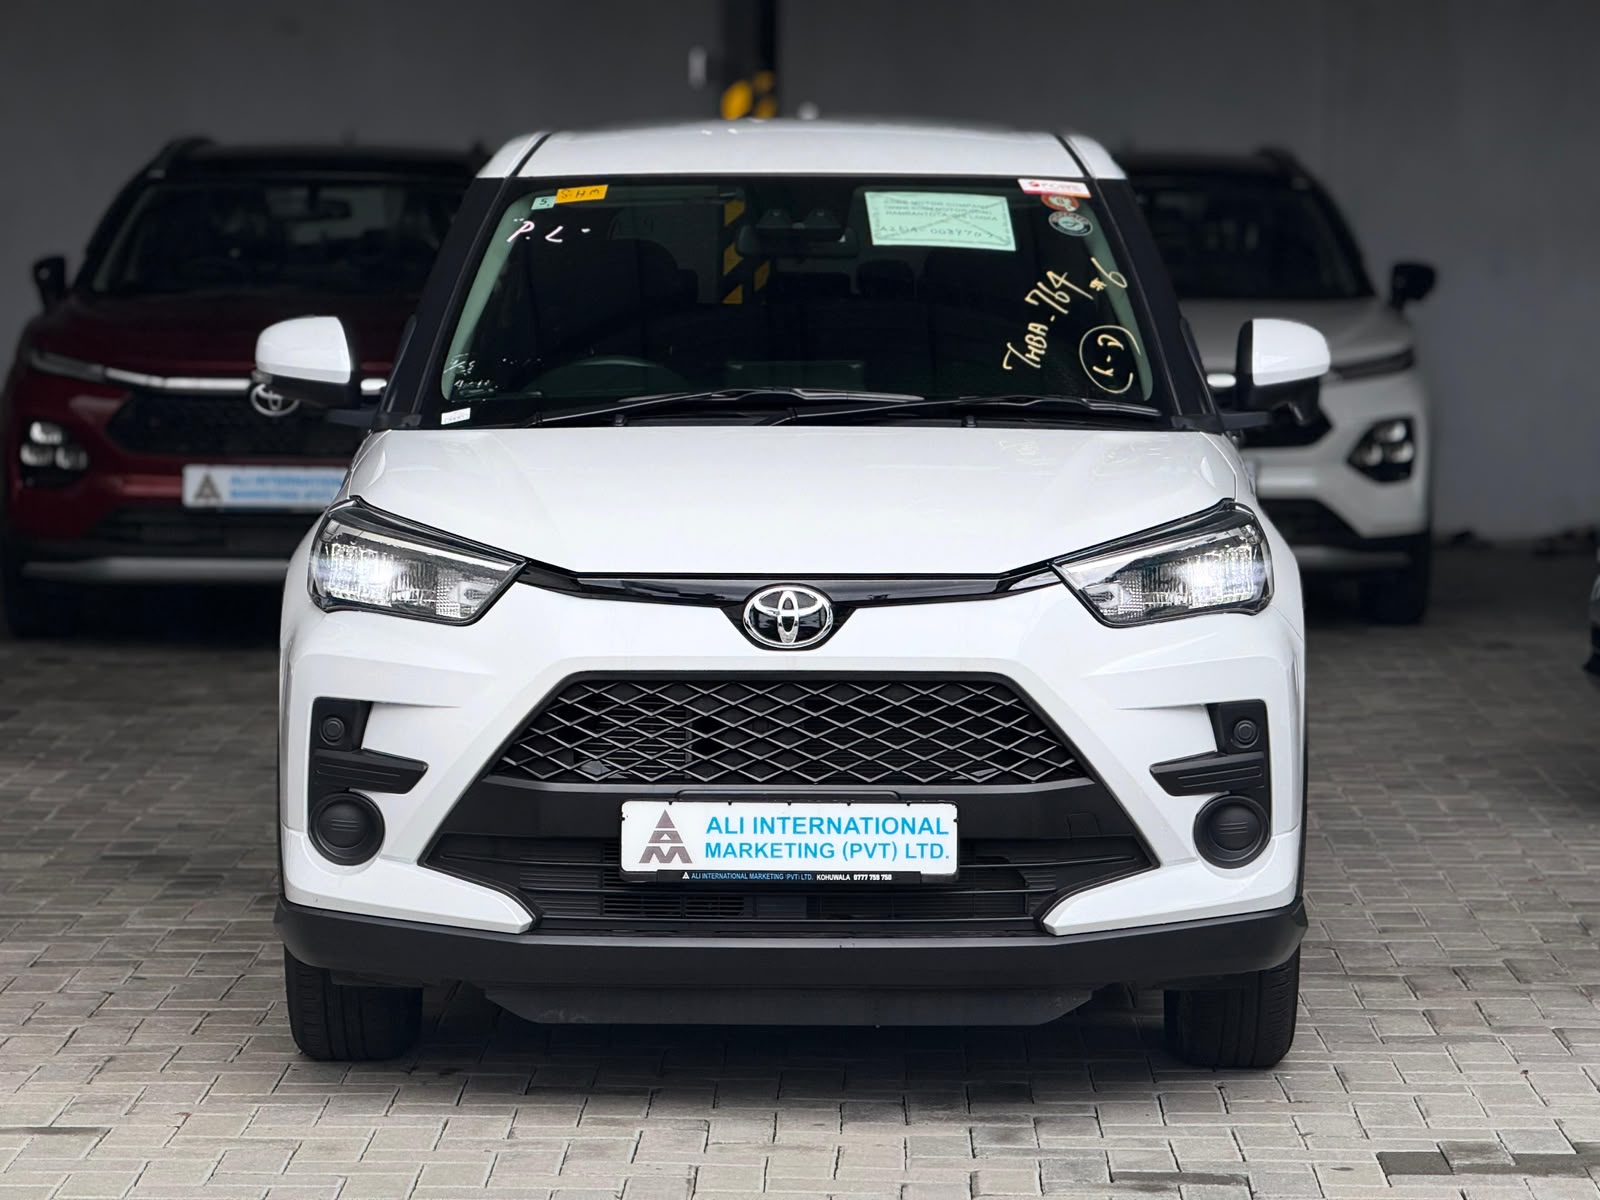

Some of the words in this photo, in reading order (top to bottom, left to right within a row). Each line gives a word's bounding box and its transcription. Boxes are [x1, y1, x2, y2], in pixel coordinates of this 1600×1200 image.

[705, 816, 745, 835] ALI
[752, 816, 950, 836] INTERNATIONAL
[704, 842, 836, 860] MARKETING
[841, 842, 899, 863] (PVT)
[904, 842, 950, 861] LTD.
[702, 872, 748, 880] INTERNATIONAL
[749, 872, 784, 880] MARKETING
[816, 873, 851, 881] KOHUWALA
